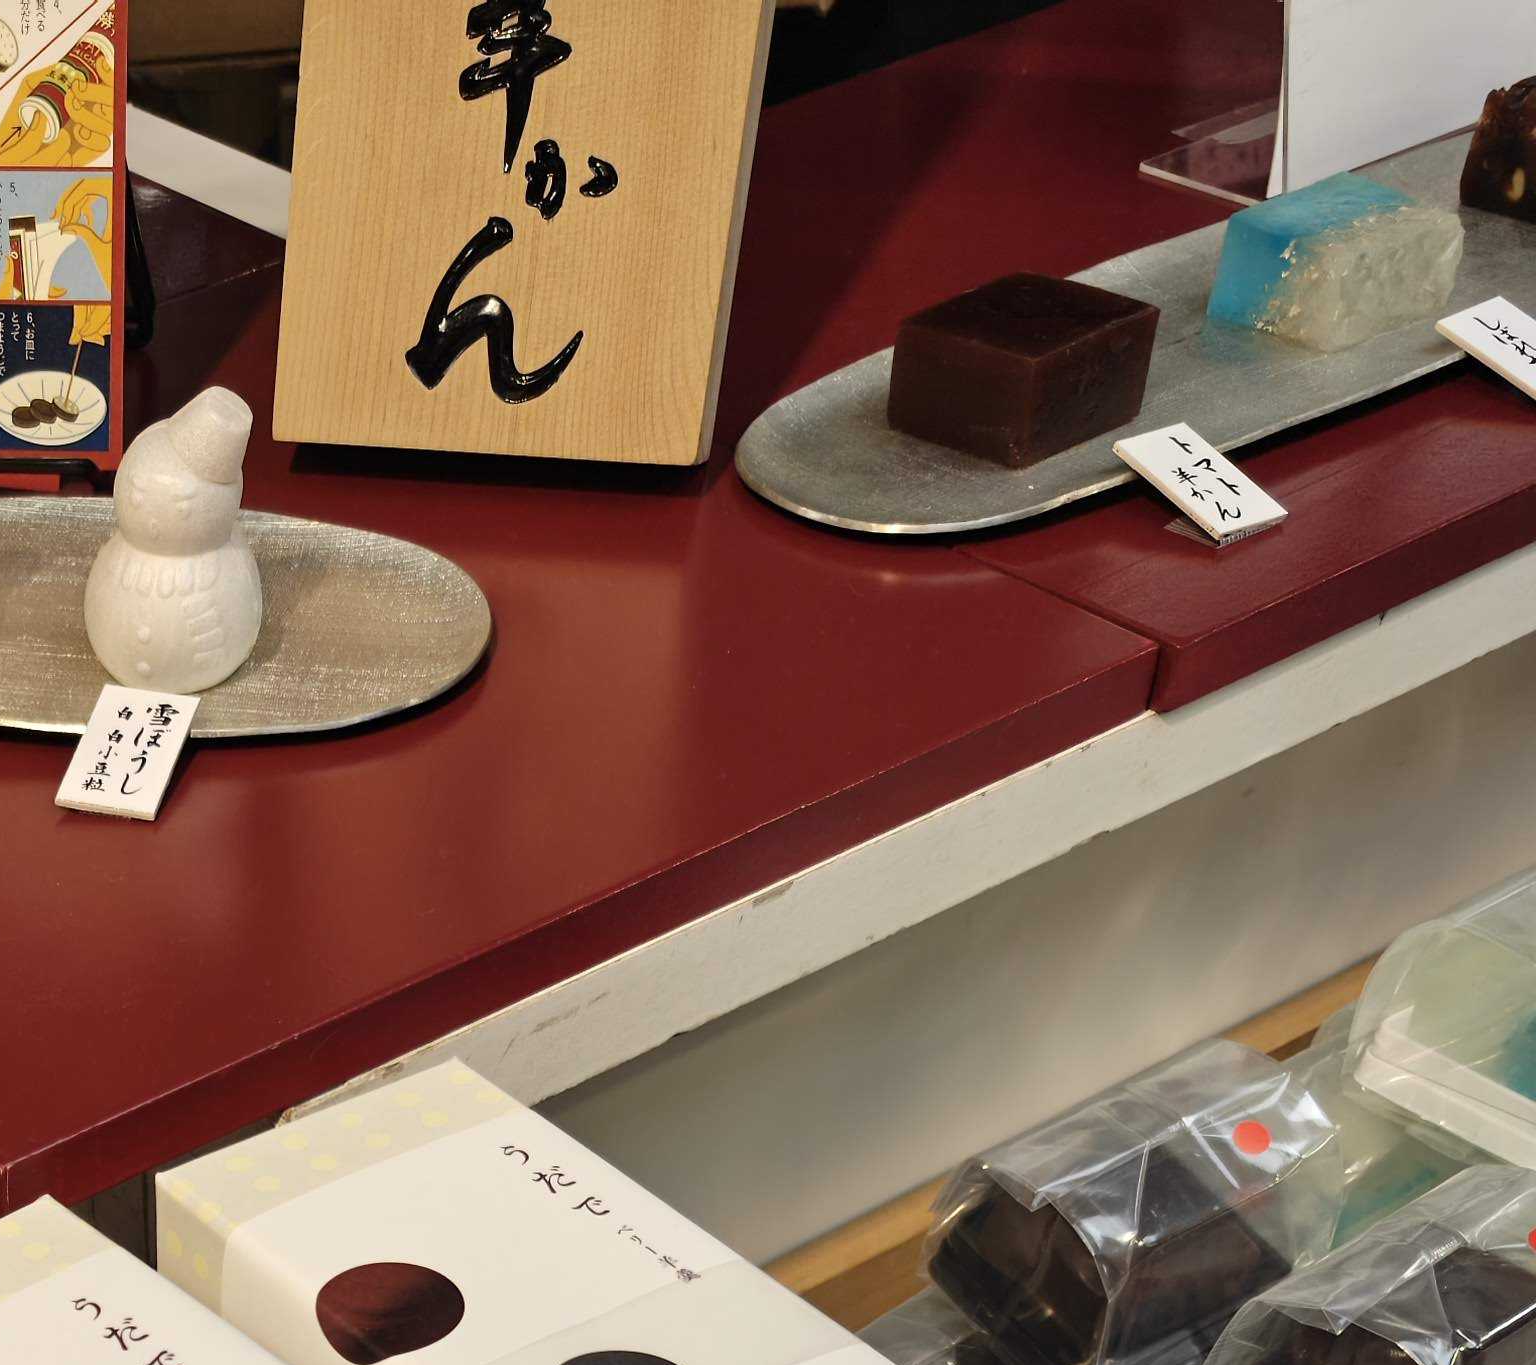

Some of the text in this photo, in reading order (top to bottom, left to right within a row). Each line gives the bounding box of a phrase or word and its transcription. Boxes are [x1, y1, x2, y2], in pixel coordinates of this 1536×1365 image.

[1168, 435, 1240, 496] トマト
[1171, 465, 1242, 521] 羊かん
[119, 703, 181, 796] 雪ぼうし
